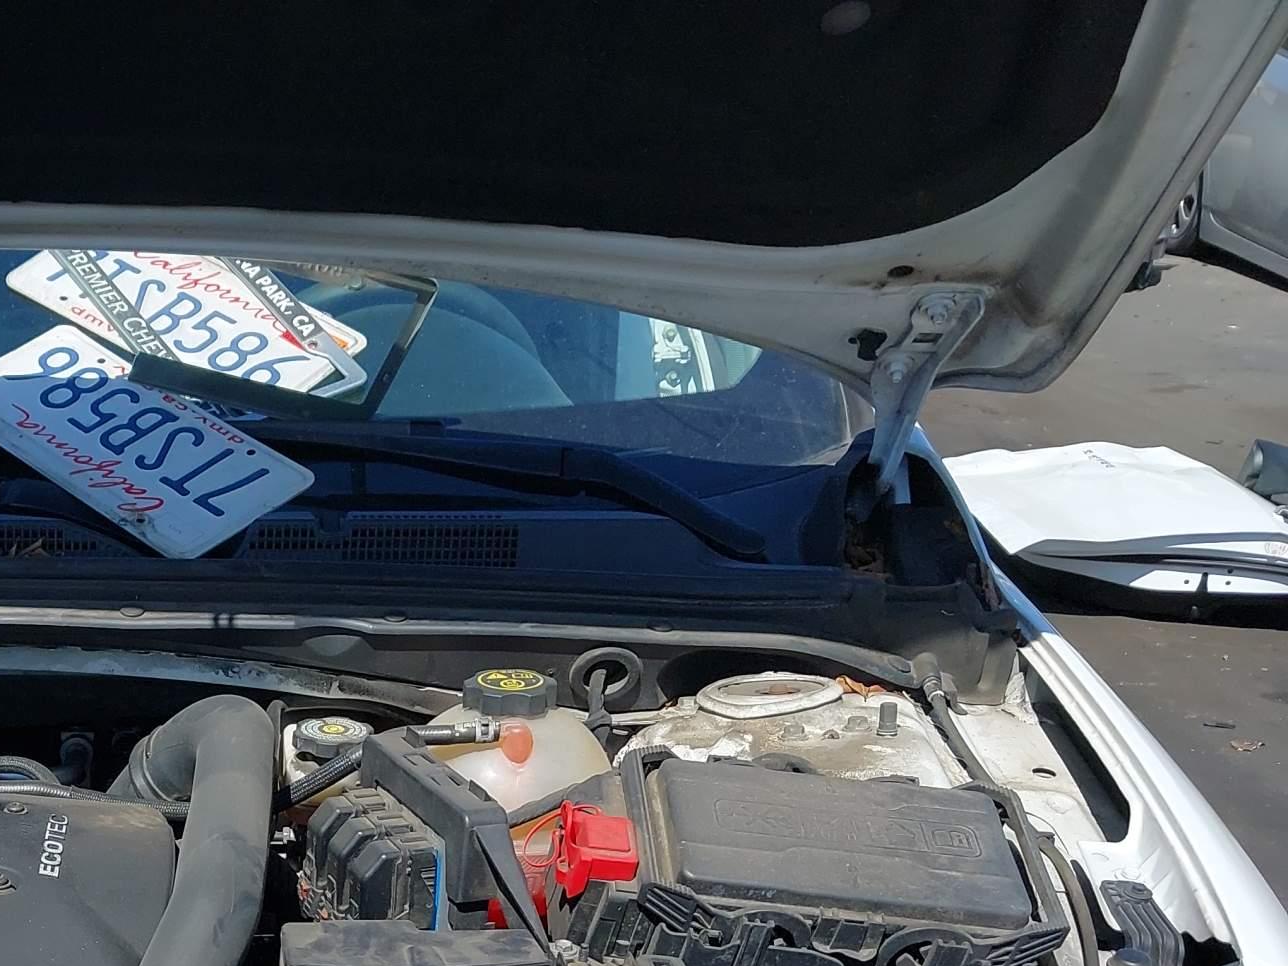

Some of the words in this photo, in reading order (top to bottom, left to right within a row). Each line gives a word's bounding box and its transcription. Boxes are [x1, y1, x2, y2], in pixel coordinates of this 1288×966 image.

[67, 248, 129, 314] REMIER
[256, 275, 296, 315] PARK,
[292, 314, 316, 338] CA
[3, 347, 270, 517] 7TSB586
[11, 402, 165, 513] California
[38, 813, 69, 878] ECOTEC
